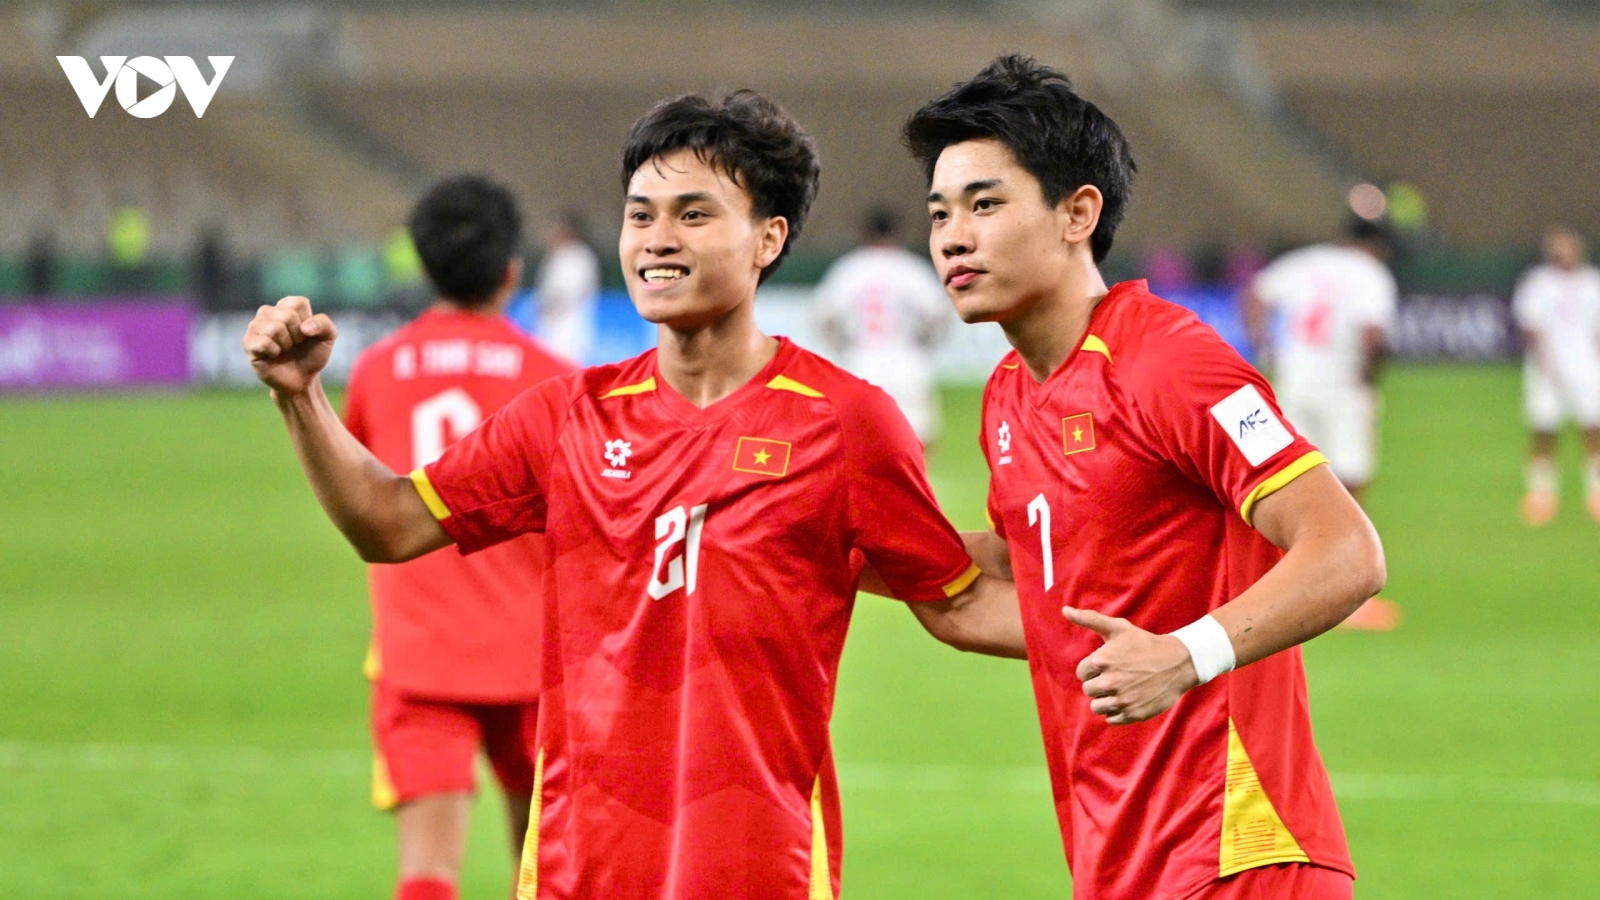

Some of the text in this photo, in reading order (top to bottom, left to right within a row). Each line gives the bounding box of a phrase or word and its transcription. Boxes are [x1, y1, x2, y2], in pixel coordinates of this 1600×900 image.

[1239, 408, 1268, 440] AFC
[647, 503, 708, 600] 21
[1026, 492, 1054, 593] 7
